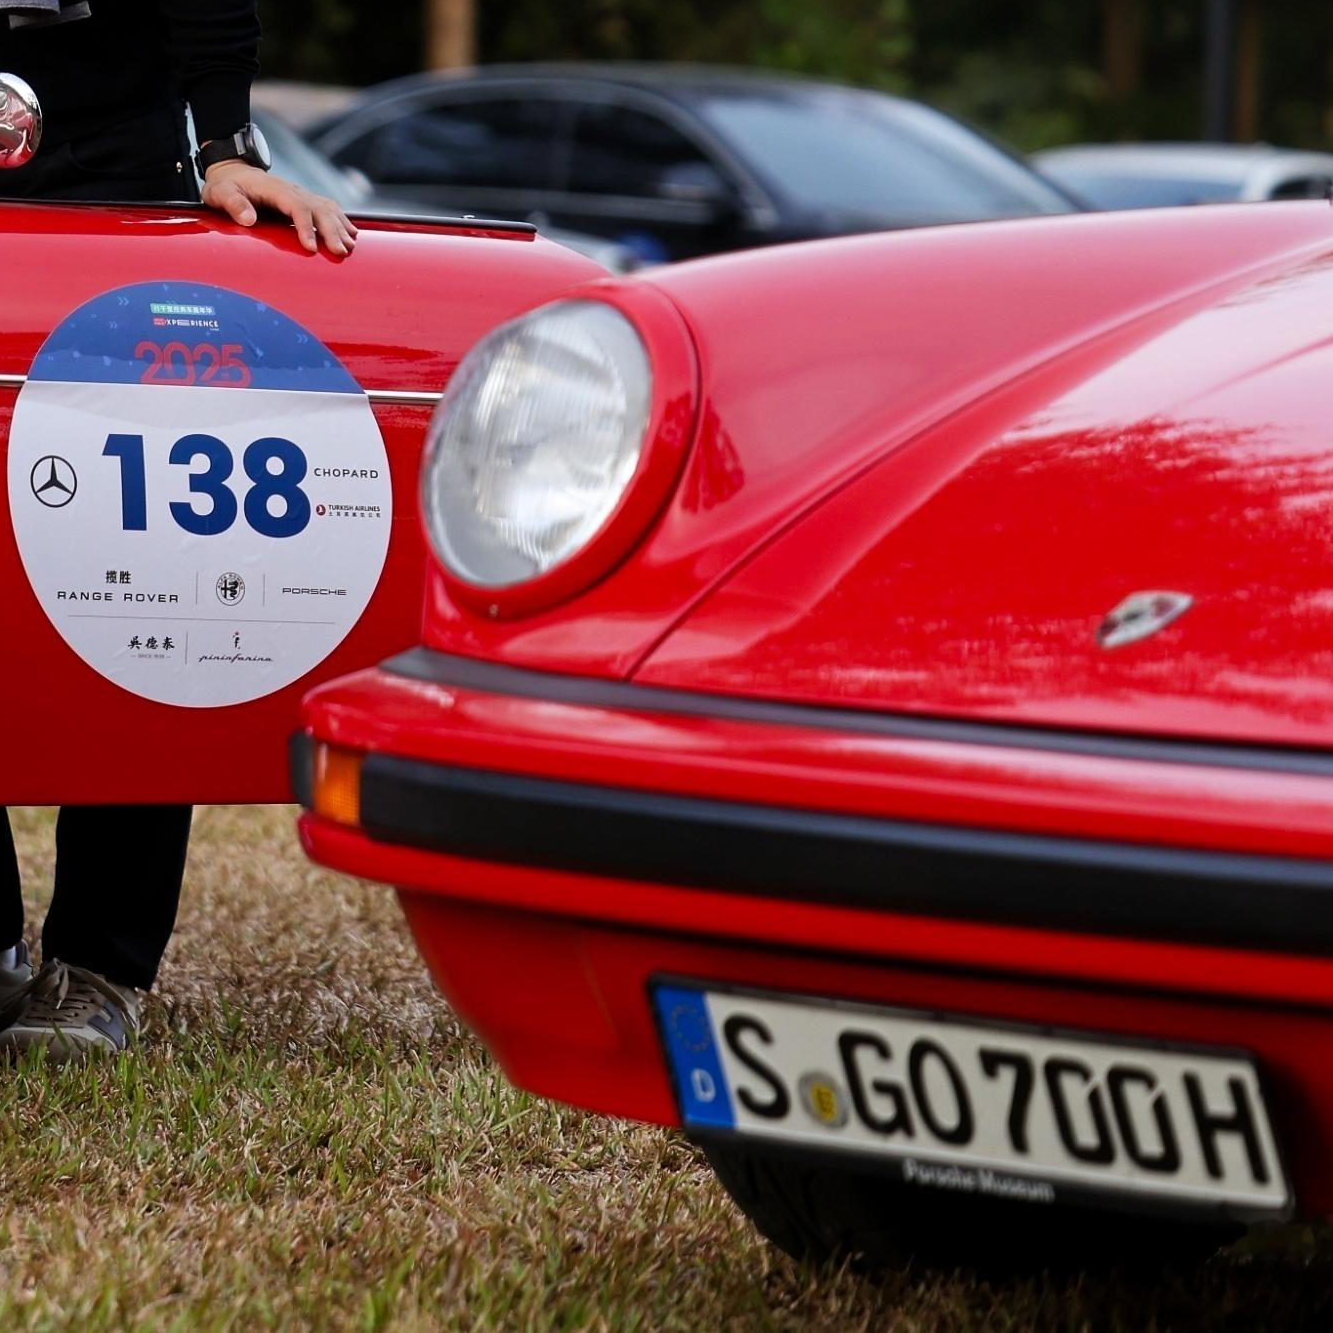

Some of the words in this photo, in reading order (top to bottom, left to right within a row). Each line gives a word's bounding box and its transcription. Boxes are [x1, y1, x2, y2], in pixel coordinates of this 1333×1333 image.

[134, 340, 252, 387] 2025
[314, 468, 378, 478] CHOPARD
[102, 434, 311, 537] 138
[106, 570, 131, 584] 揽胜
[57, 591, 113, 601] RANGE
[124, 593, 178, 603] ROVER
[199, 653, 273, 663] pininfarina
[723, 1014, 790, 1120] S
[690, 1069, 716, 1103] D
